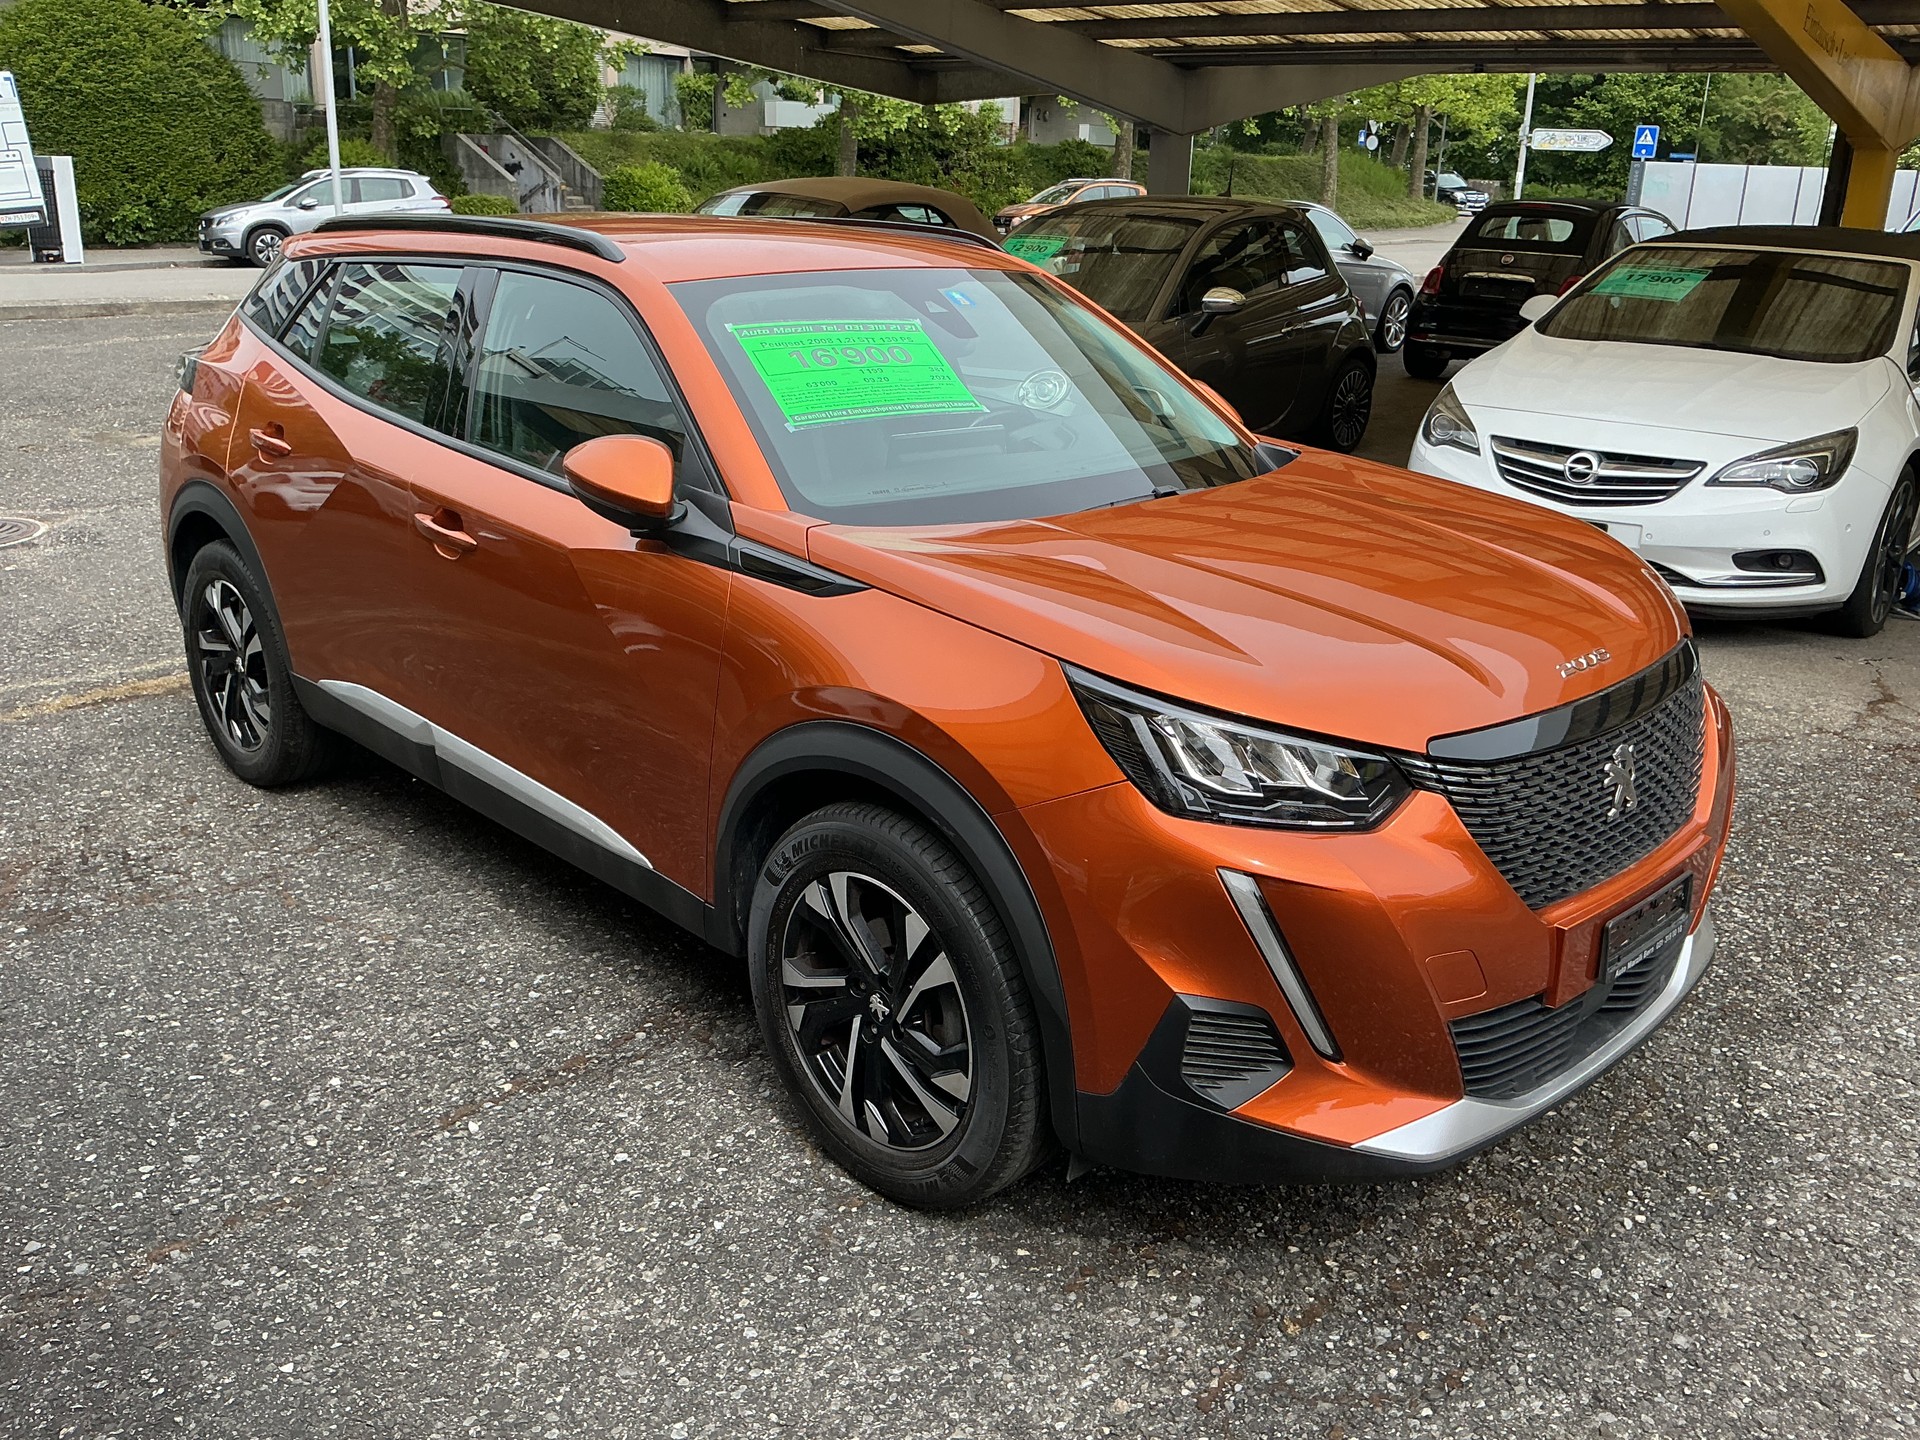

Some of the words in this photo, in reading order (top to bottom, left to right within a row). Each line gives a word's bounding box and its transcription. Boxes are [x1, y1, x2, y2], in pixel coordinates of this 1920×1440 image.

[1626, 274, 1686, 284] 17'900
[741, 329, 770, 337] Auto
[773, 325, 813, 334] Marzili
[760, 340, 806, 348] Peugeot
[788, 346, 913, 369] 16'900
[1555, 647, 1611, 679] 2008
